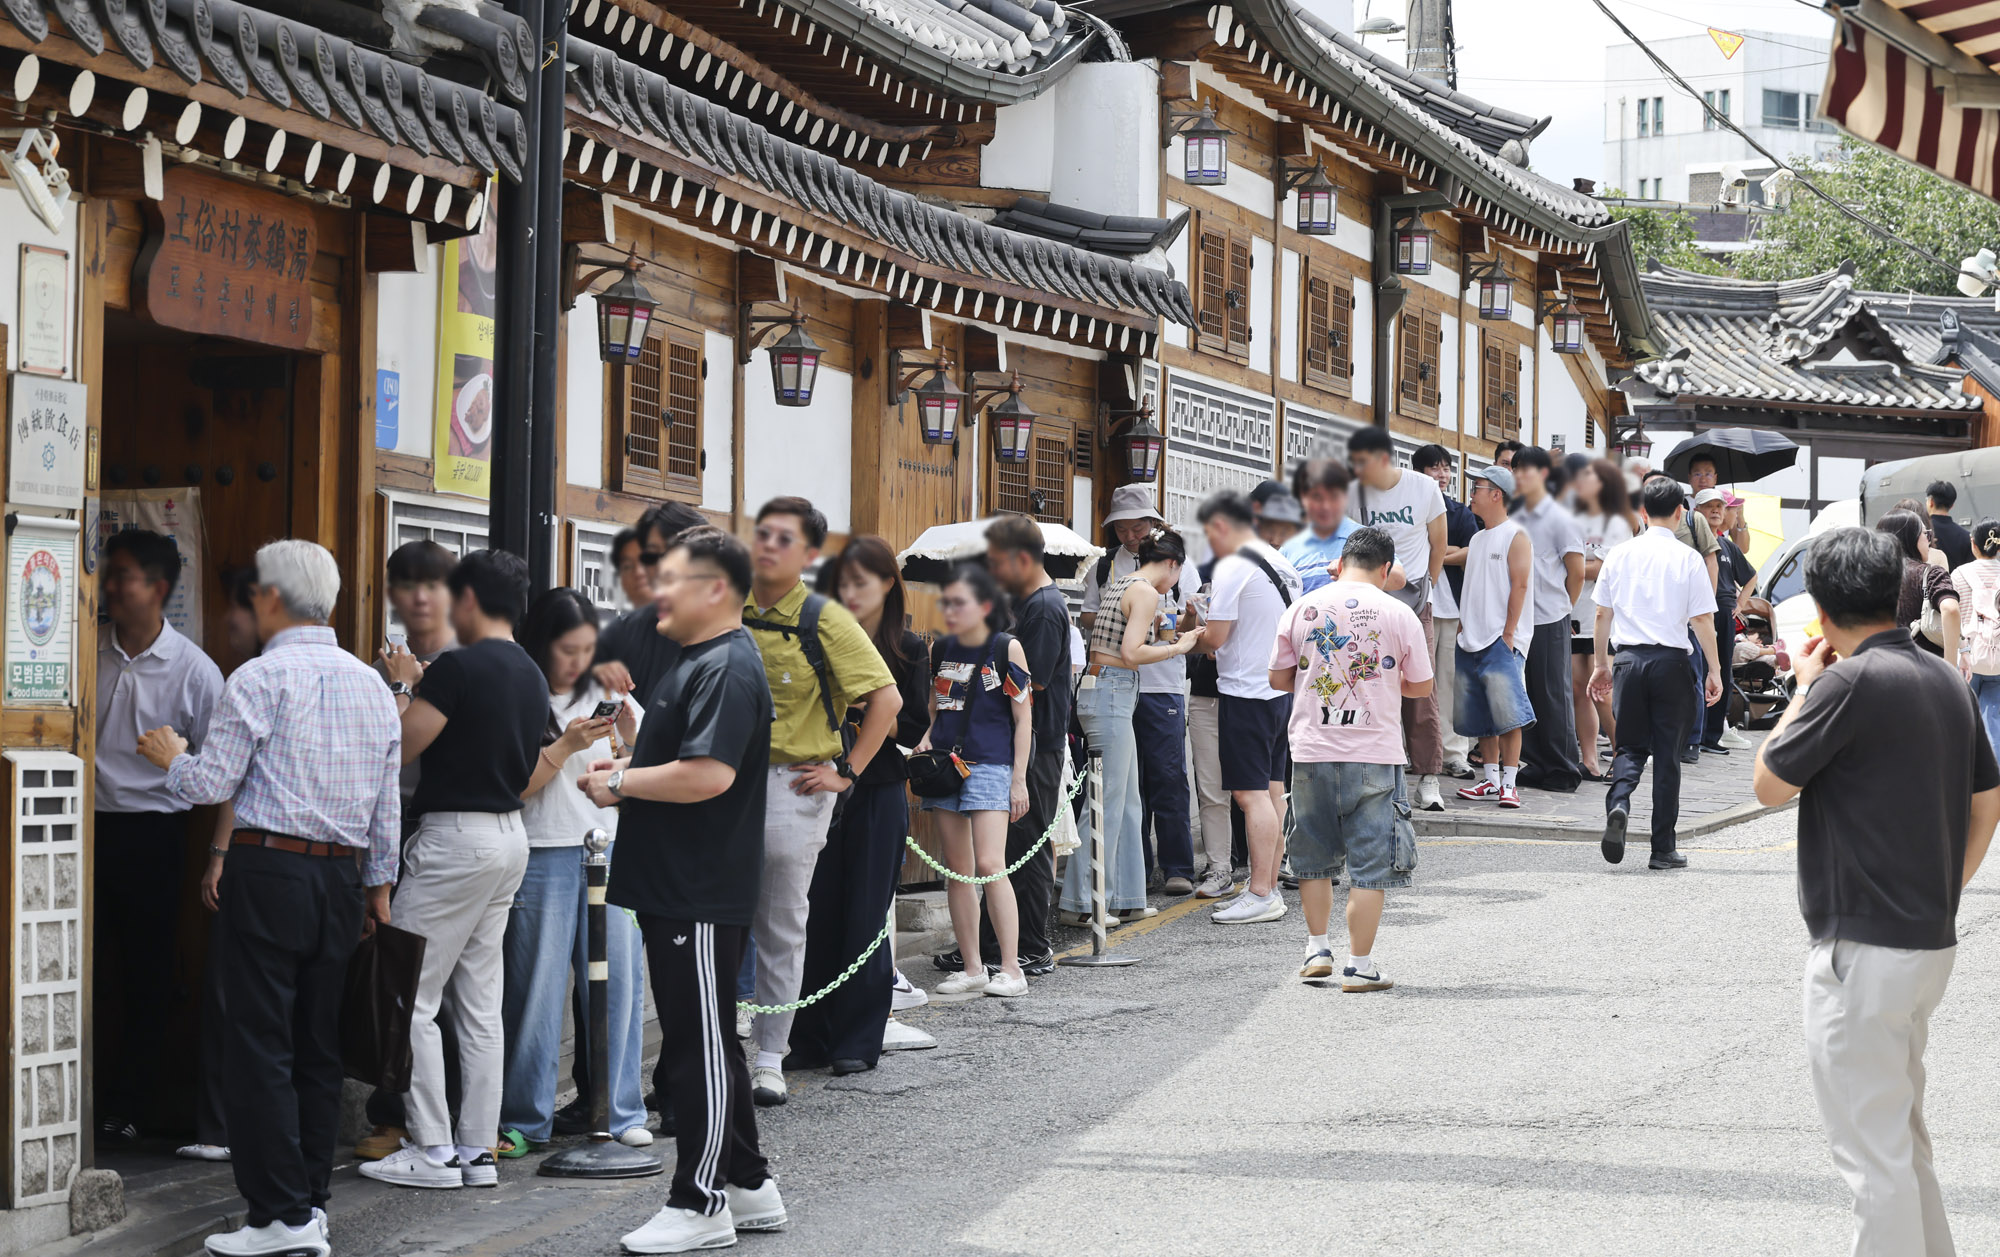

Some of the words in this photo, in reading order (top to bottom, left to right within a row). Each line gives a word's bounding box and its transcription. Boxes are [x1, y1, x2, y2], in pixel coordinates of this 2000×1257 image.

[1349, 614, 1378, 622] Campus
[12, 664, 65, 684] 모범음식점
[12, 686, 30, 698] Good
